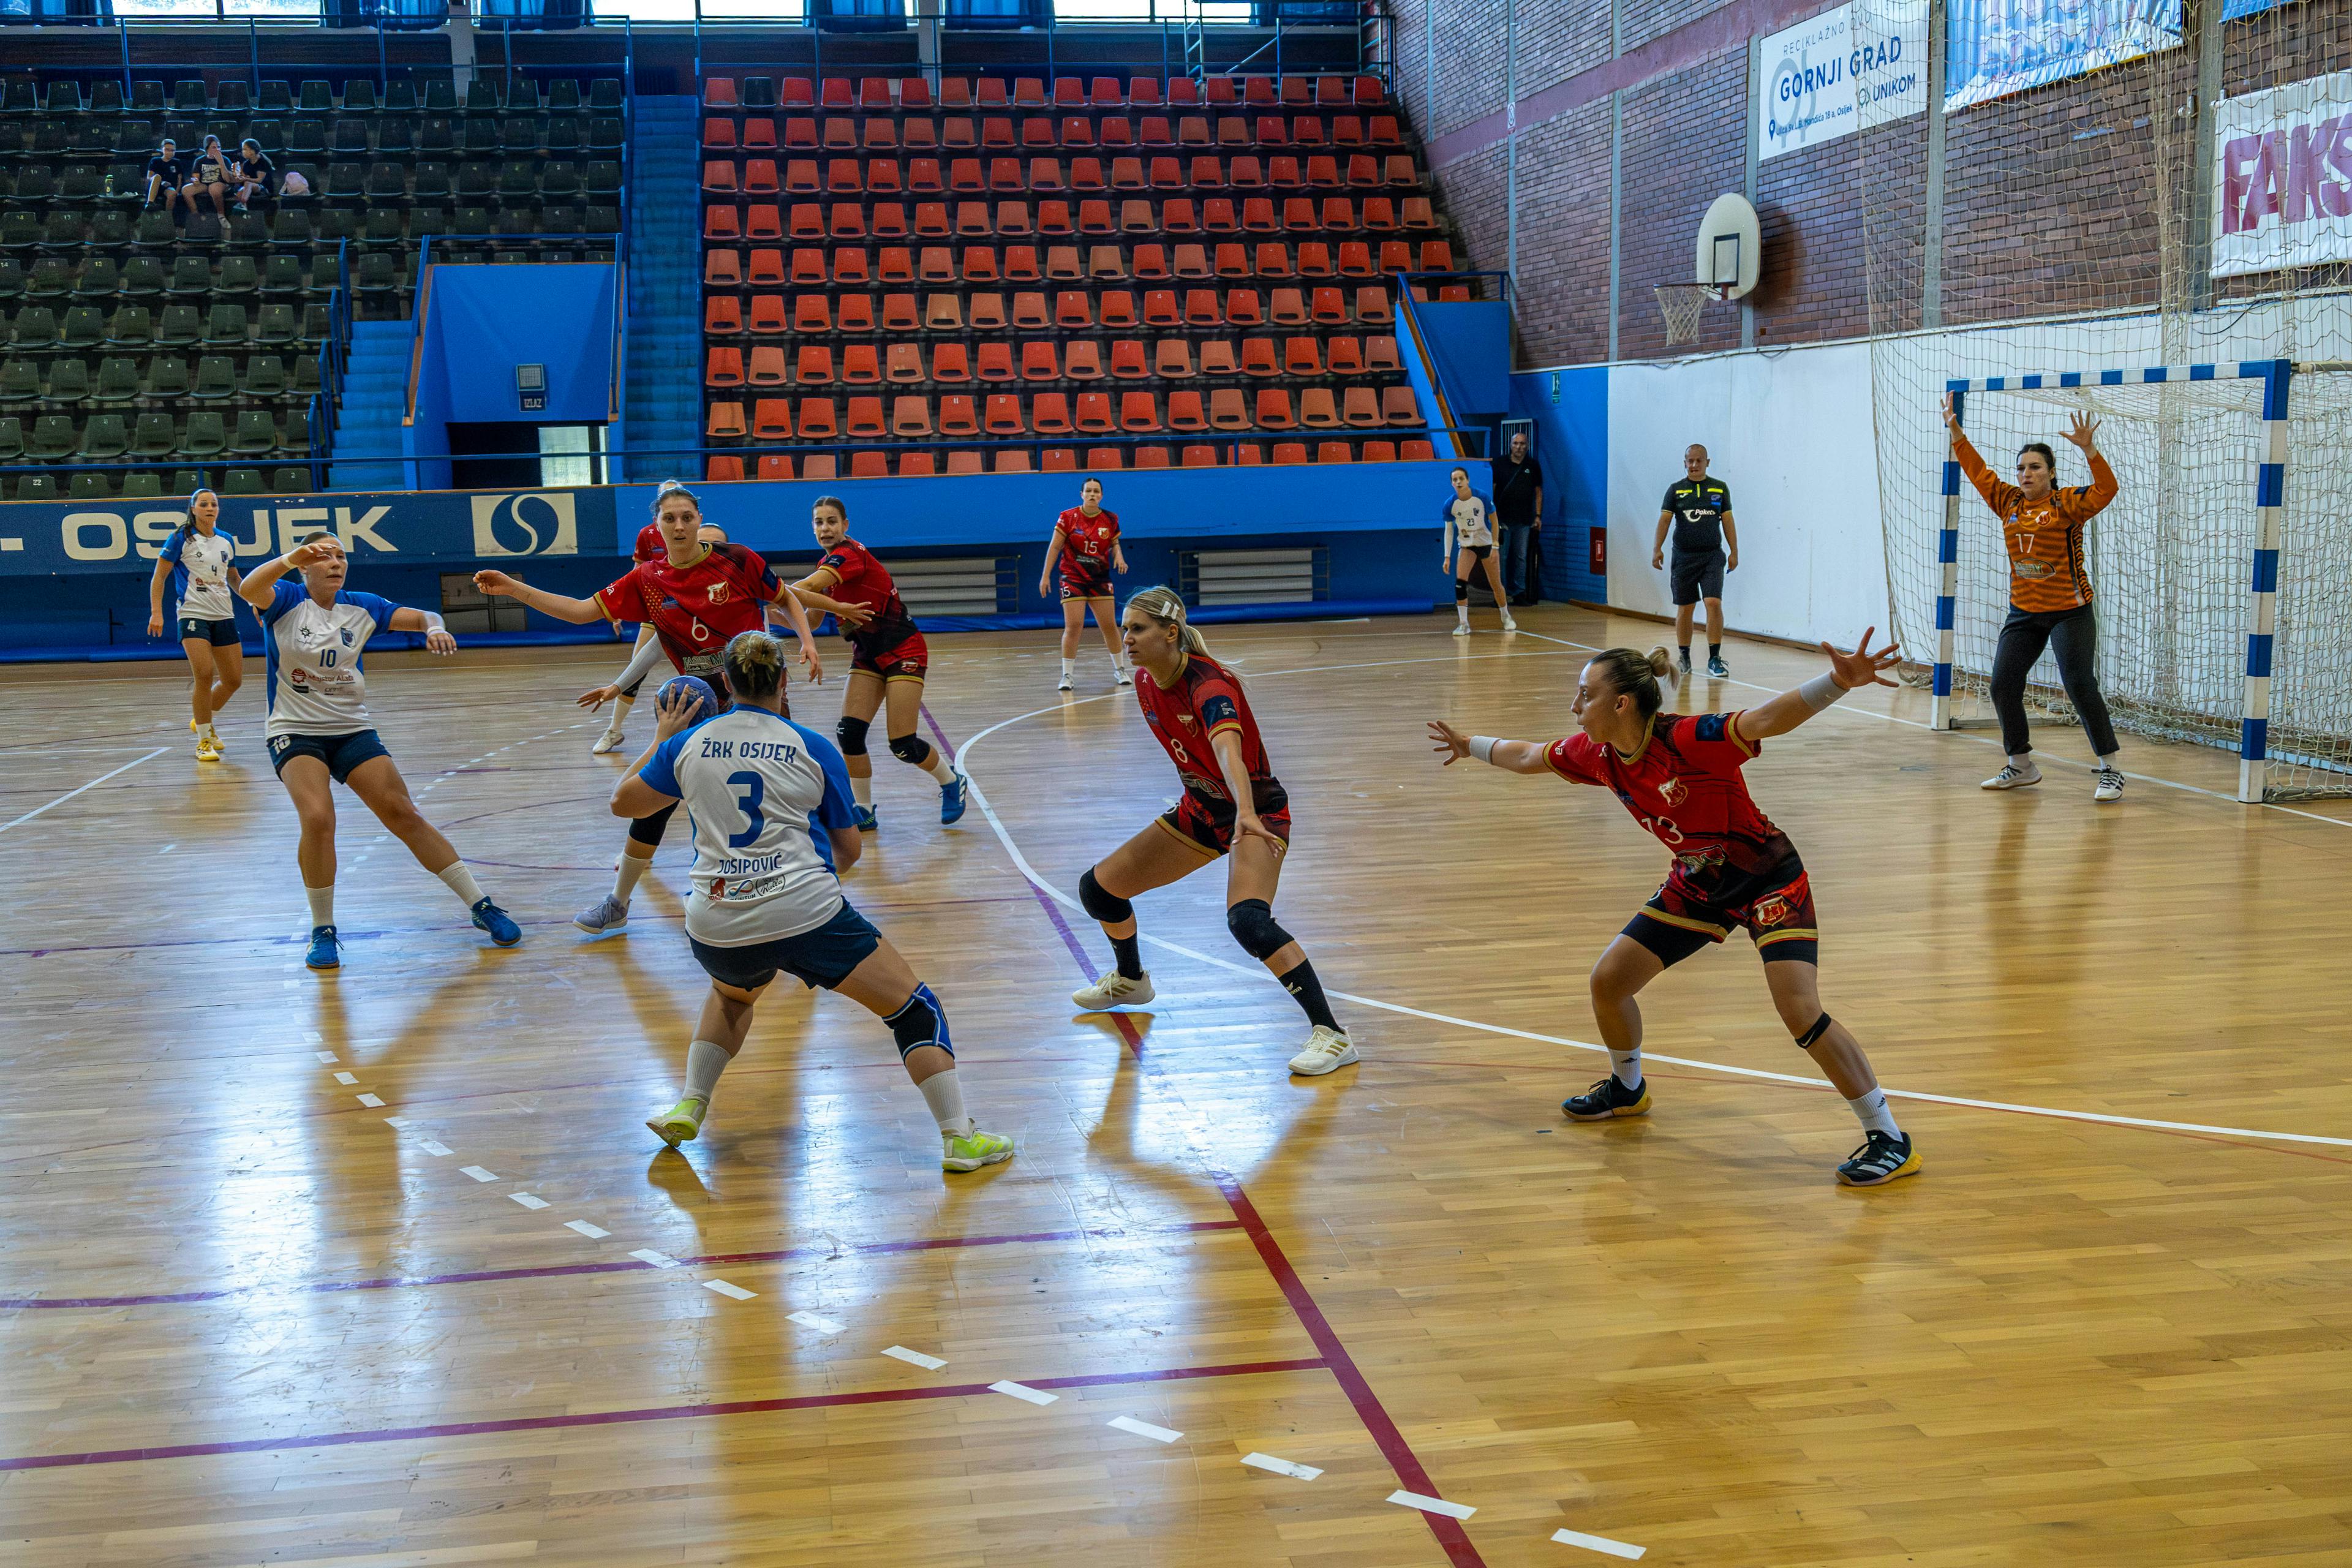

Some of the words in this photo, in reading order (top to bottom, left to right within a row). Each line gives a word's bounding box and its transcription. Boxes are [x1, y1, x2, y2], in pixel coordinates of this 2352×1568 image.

[1784, 21, 1844, 56] RECIKLAŽNO
[1781, 57, 1841, 101] GORNJI
[1850, 36, 1901, 77] GRAD
[1873, 73, 1915, 102] UNIKOM
[62, 505, 399, 561] OSJEK
[2016, 533, 2035, 554] 17
[1084, 540, 1098, 554] 15
[211, 565, 217, 576] 4
[692, 616, 709, 642] 6
[319, 649, 337, 668] 10
[701, 737, 734, 758] ŽRK
[739, 741, 796, 764] OSIJEK
[1170, 738, 1188, 764] 8
[726, 771, 764, 848] 3
[1641, 815, 1684, 845] 13
[717, 852, 782, 875] JOSIPOVIĆ
